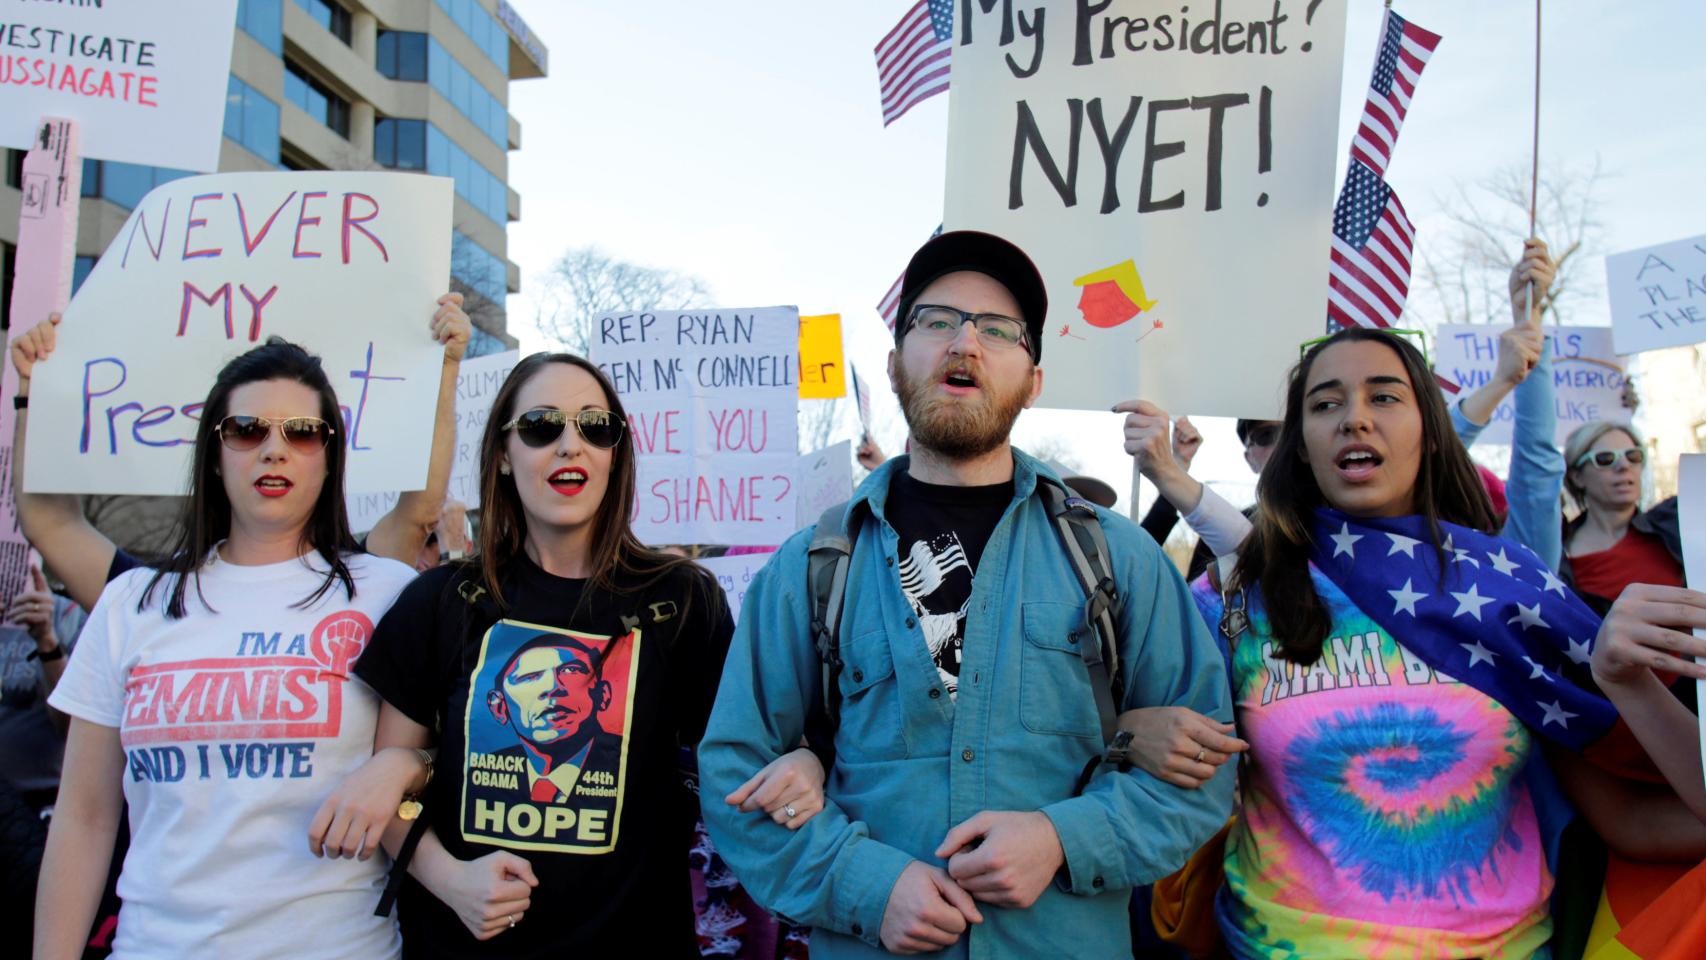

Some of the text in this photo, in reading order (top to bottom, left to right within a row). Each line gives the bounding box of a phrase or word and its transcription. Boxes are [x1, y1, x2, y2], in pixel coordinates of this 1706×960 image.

[960, 0, 1323, 78] My President?
[1008, 85, 1273, 214] NYET!
[121, 191, 389, 268] NEVER
[1636, 253, 1675, 280] A
[176, 281, 278, 341] MY
[601, 312, 753, 345] REP. RYAN
[697, 354, 793, 388] CONNELL
[1553, 370, 1626, 390] MERICA
[79, 341, 406, 455] Prest
[1555, 399, 1600, 421] LIKE
[628, 408, 767, 454] AVE YOU
[650, 475, 792, 524] SHAME?
[286, 634, 306, 656] A
[124, 668, 347, 732] EMINIST
[129, 742, 316, 783] AND I VOTE
[469, 752, 525, 773] BARACK
[472, 771, 519, 790] OBAMA
[582, 770, 614, 786] 44th
[575, 785, 618, 798] President
[474, 799, 608, 841] HOPE
